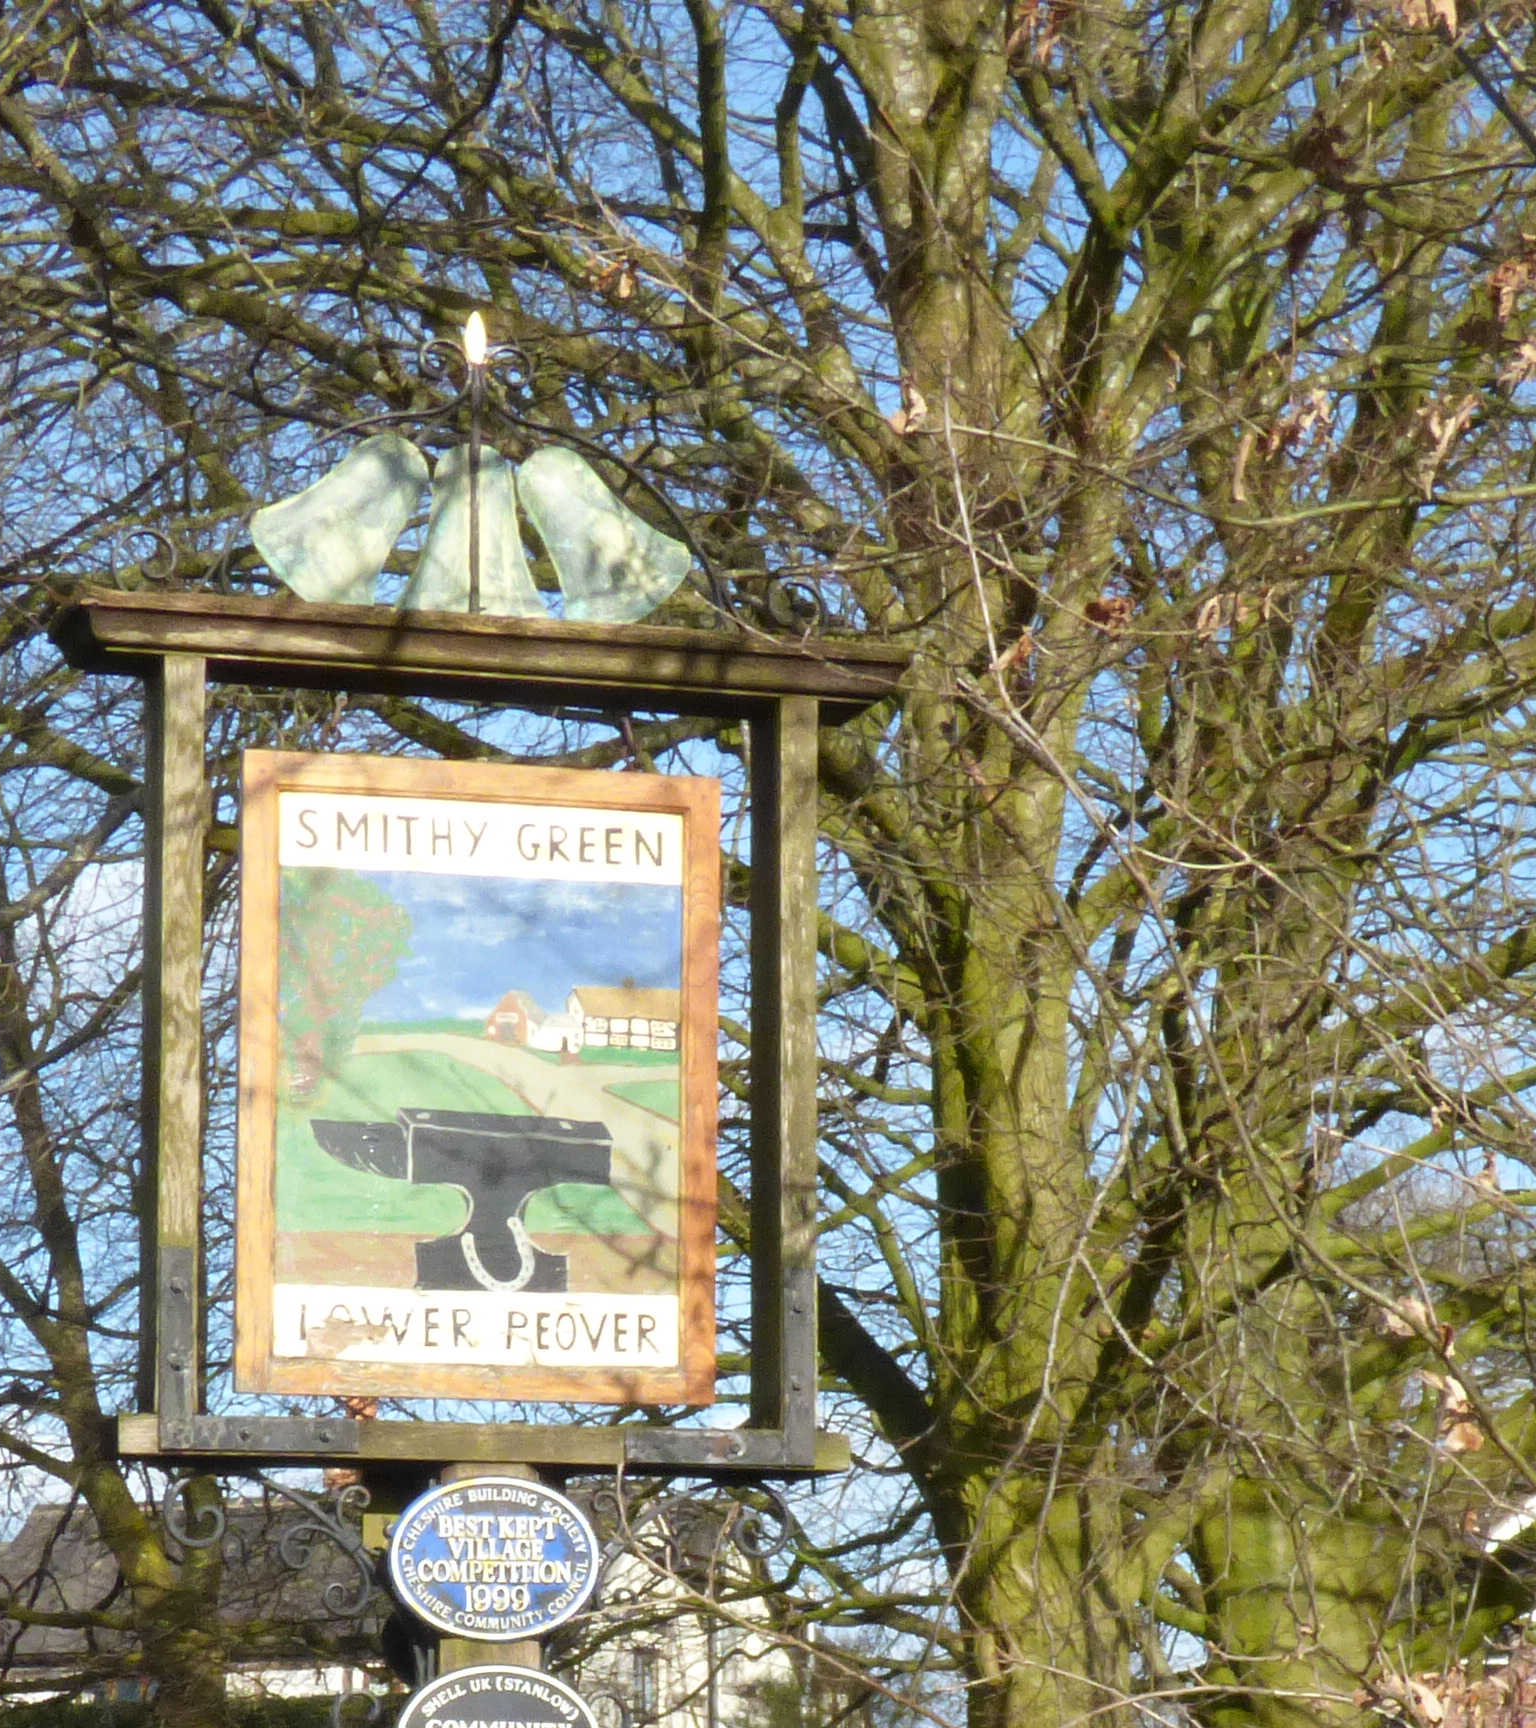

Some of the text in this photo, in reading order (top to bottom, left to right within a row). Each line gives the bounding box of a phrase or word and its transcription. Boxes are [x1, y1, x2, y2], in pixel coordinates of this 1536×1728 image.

[295, 809, 663, 867] SMITHY GREEN
[506, 1311, 659, 1354] PEOVER
[403, 1488, 587, 1553] CHESHIRE BUILDING SOCIETY
[438, 1515, 557, 1540] BEST KEPT
[448, 1538, 544, 1561] VILLAGE
[402, 1554, 589, 1629] CHESHIRE COMMUNITY COUNCIL
[417, 1560, 572, 1584] COMPETITION
[464, 1584, 530, 1613] 1999
[421, 1676, 580, 1721] SHELL UK (STANLOW)
